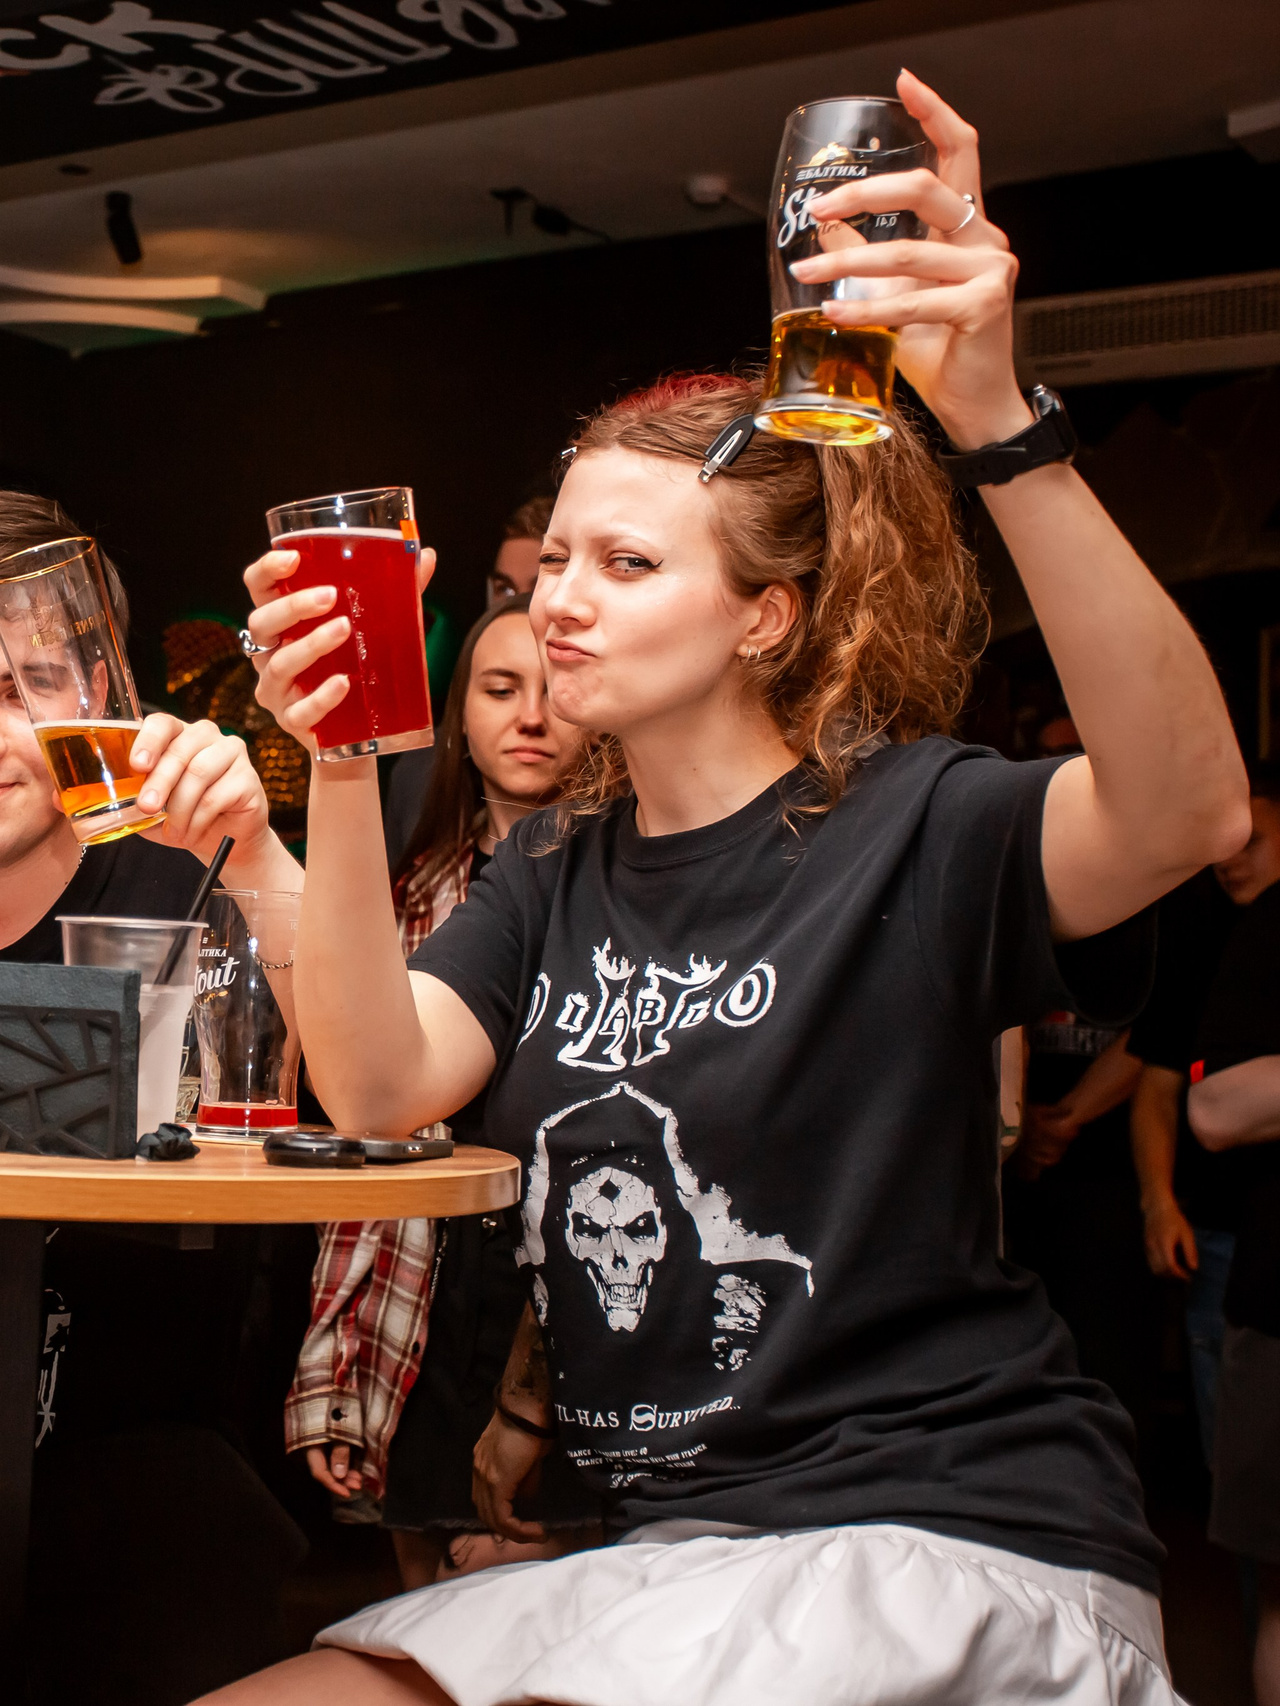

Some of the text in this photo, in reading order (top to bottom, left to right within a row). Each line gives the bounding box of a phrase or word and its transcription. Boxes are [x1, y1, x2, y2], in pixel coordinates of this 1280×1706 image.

[803, 165, 869, 181] БАЛТИКА
[194, 957, 240, 997] tout
[576, 1409, 620, 1428] HAS
